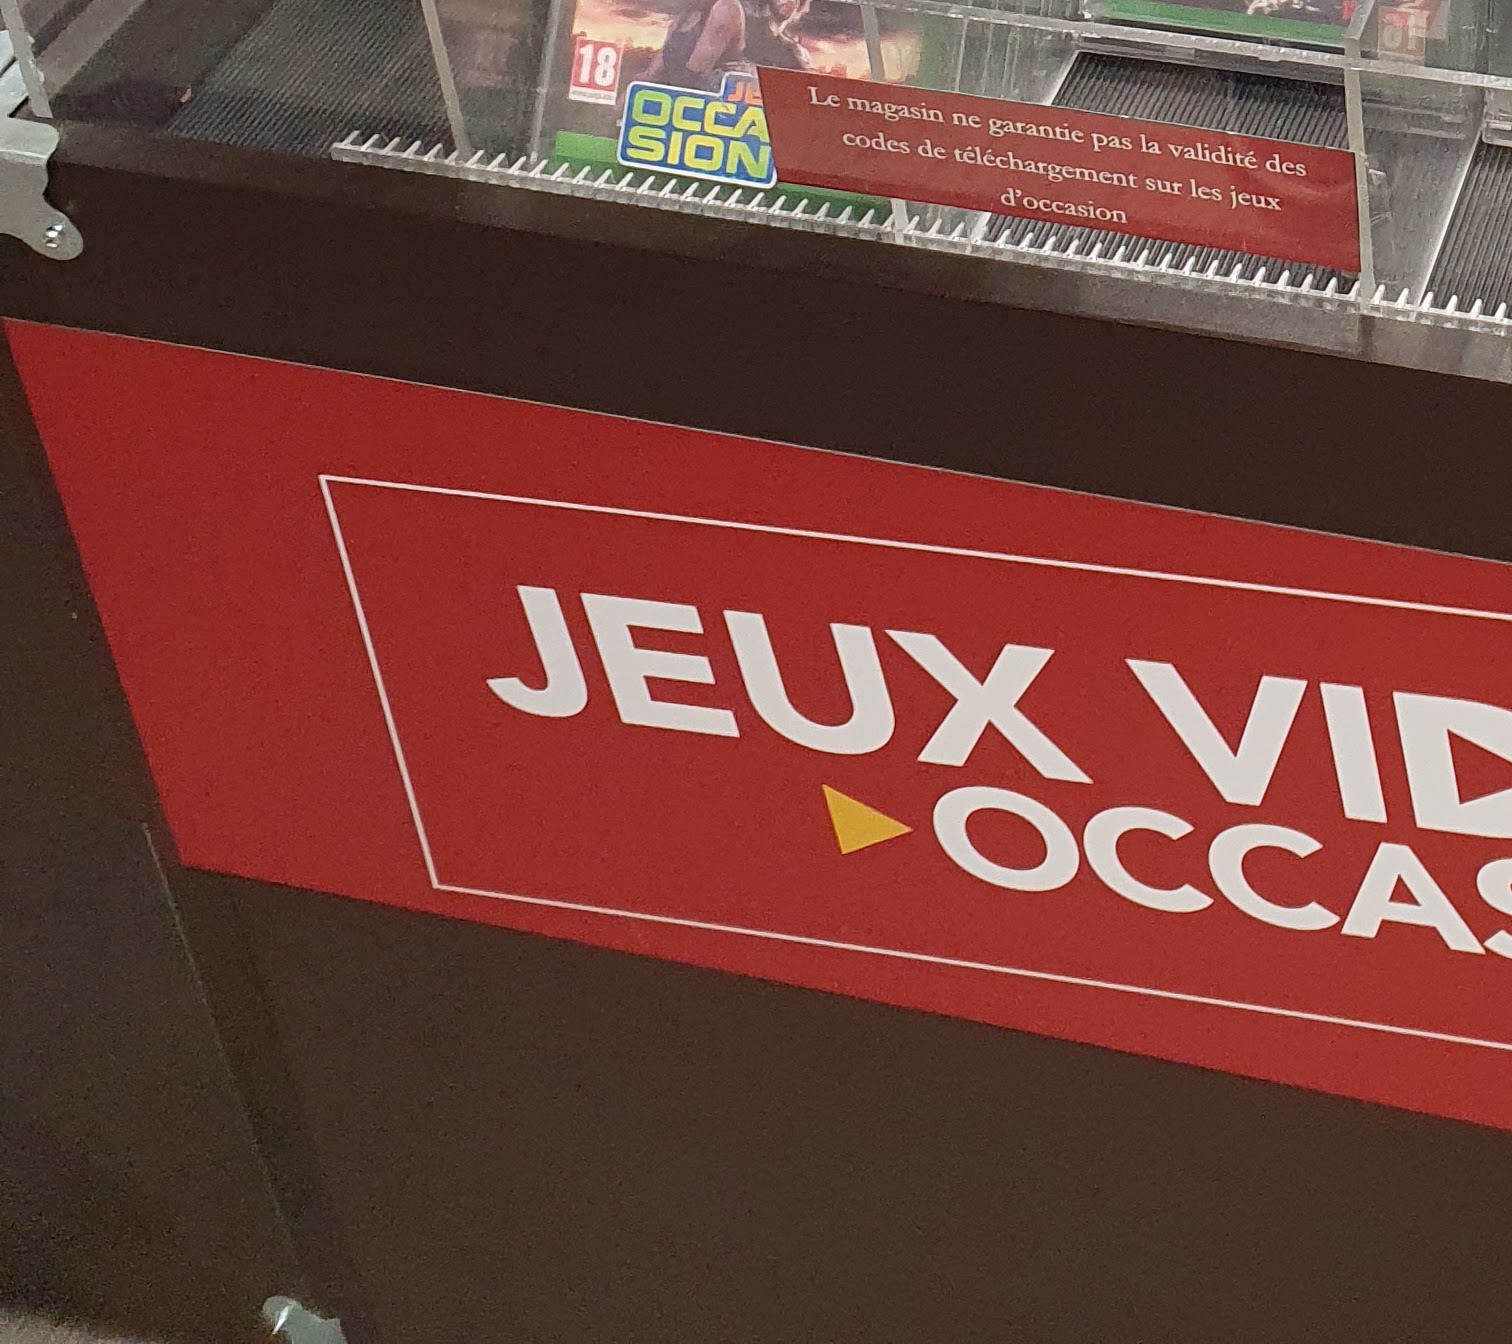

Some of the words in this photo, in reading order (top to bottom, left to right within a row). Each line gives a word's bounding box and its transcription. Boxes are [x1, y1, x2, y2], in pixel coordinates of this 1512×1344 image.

[578, 43, 617, 87] 18
[631, 88, 769, 142] OCCA
[808, 86, 840, 109] Le
[847, 93, 944, 124] magasin
[952, 111, 982, 128] ne
[988, 115, 1084, 145] garantie
[1091, 132, 1133, 153] pas
[1140, 134, 1162, 155] la
[1168, 142, 1258, 169] validité
[1266, 153, 1306, 178] des
[625, 122, 773, 179] SION
[842, 128, 911, 154] codes
[918, 137, 947, 160] de
[954, 144, 1138, 189] téléchargement
[1145, 174, 1183, 196] sur
[1190, 177, 1222, 202] les
[1228, 184, 1282, 212] jeux
[1001, 187, 1128, 226] d'occasion
[487, 584, 1092, 784] JEUX
